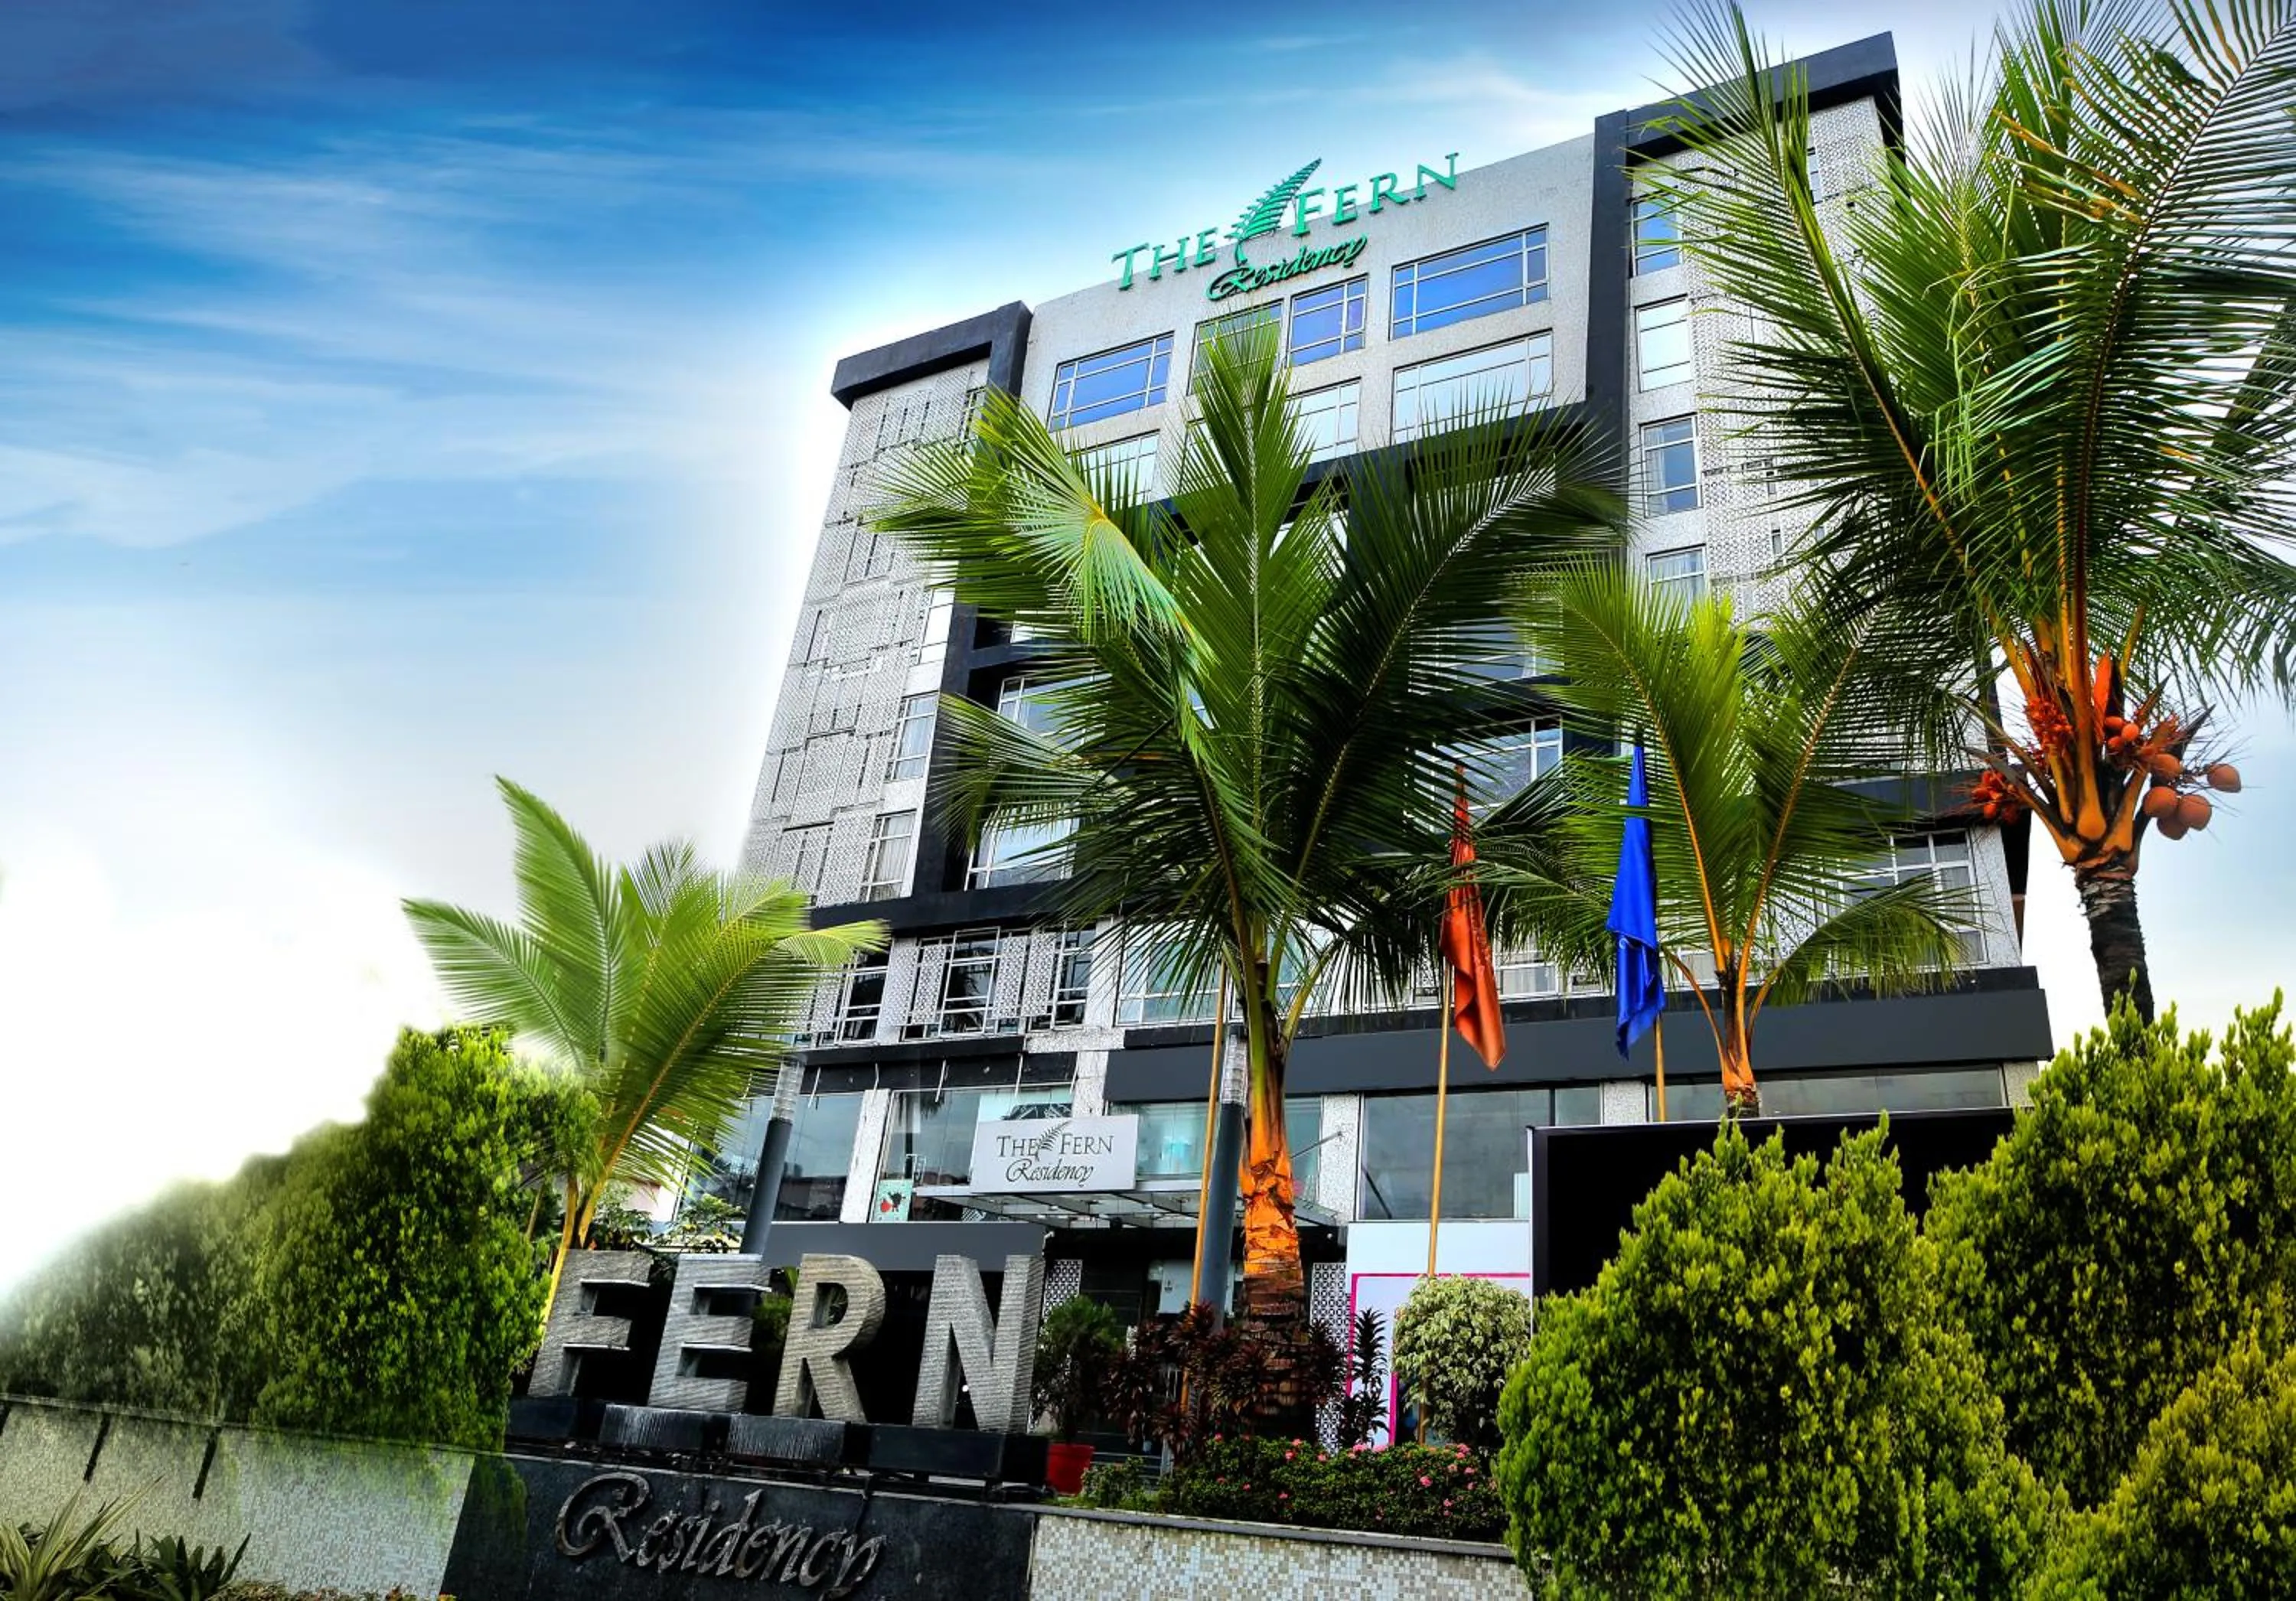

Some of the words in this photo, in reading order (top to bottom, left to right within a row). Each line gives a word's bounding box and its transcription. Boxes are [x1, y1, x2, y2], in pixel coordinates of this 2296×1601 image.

[1112, 227, 1218, 291] THE
[1292, 152, 1459, 237] FERN
[1206, 233, 1368, 301] Residency
[997, 1135, 1037, 1158] THE
[1059, 1133, 1114, 1156] FERN
[1006, 1158, 1094, 1187] Residency
[527, 1250, 1045, 1434] FERN
[555, 1472, 887, 1600] Residency
